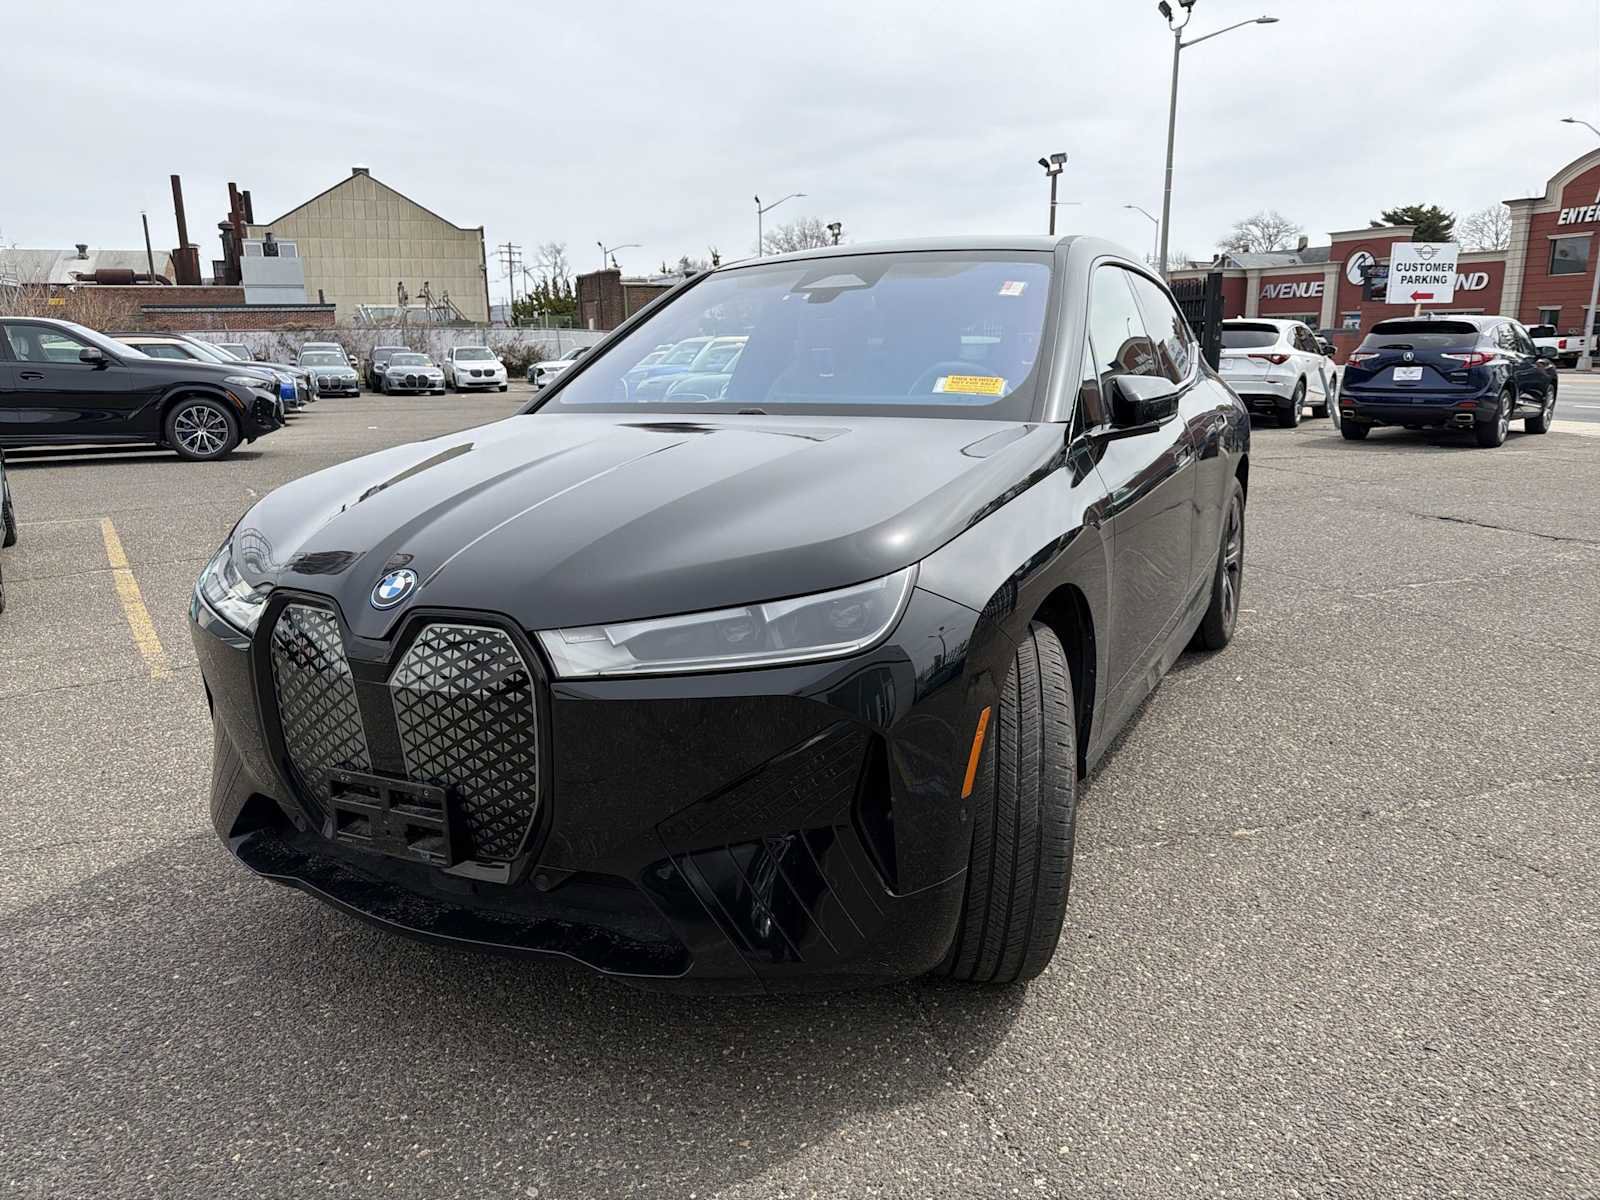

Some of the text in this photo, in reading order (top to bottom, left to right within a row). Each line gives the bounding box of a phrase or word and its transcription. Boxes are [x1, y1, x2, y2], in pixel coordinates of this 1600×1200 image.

[1396, 262, 1454, 272] CUSTOMER
[1400, 275, 1447, 284] PARKING
[1455, 272, 1489, 290] ND
[1261, 281, 1325, 298] AVENUE
